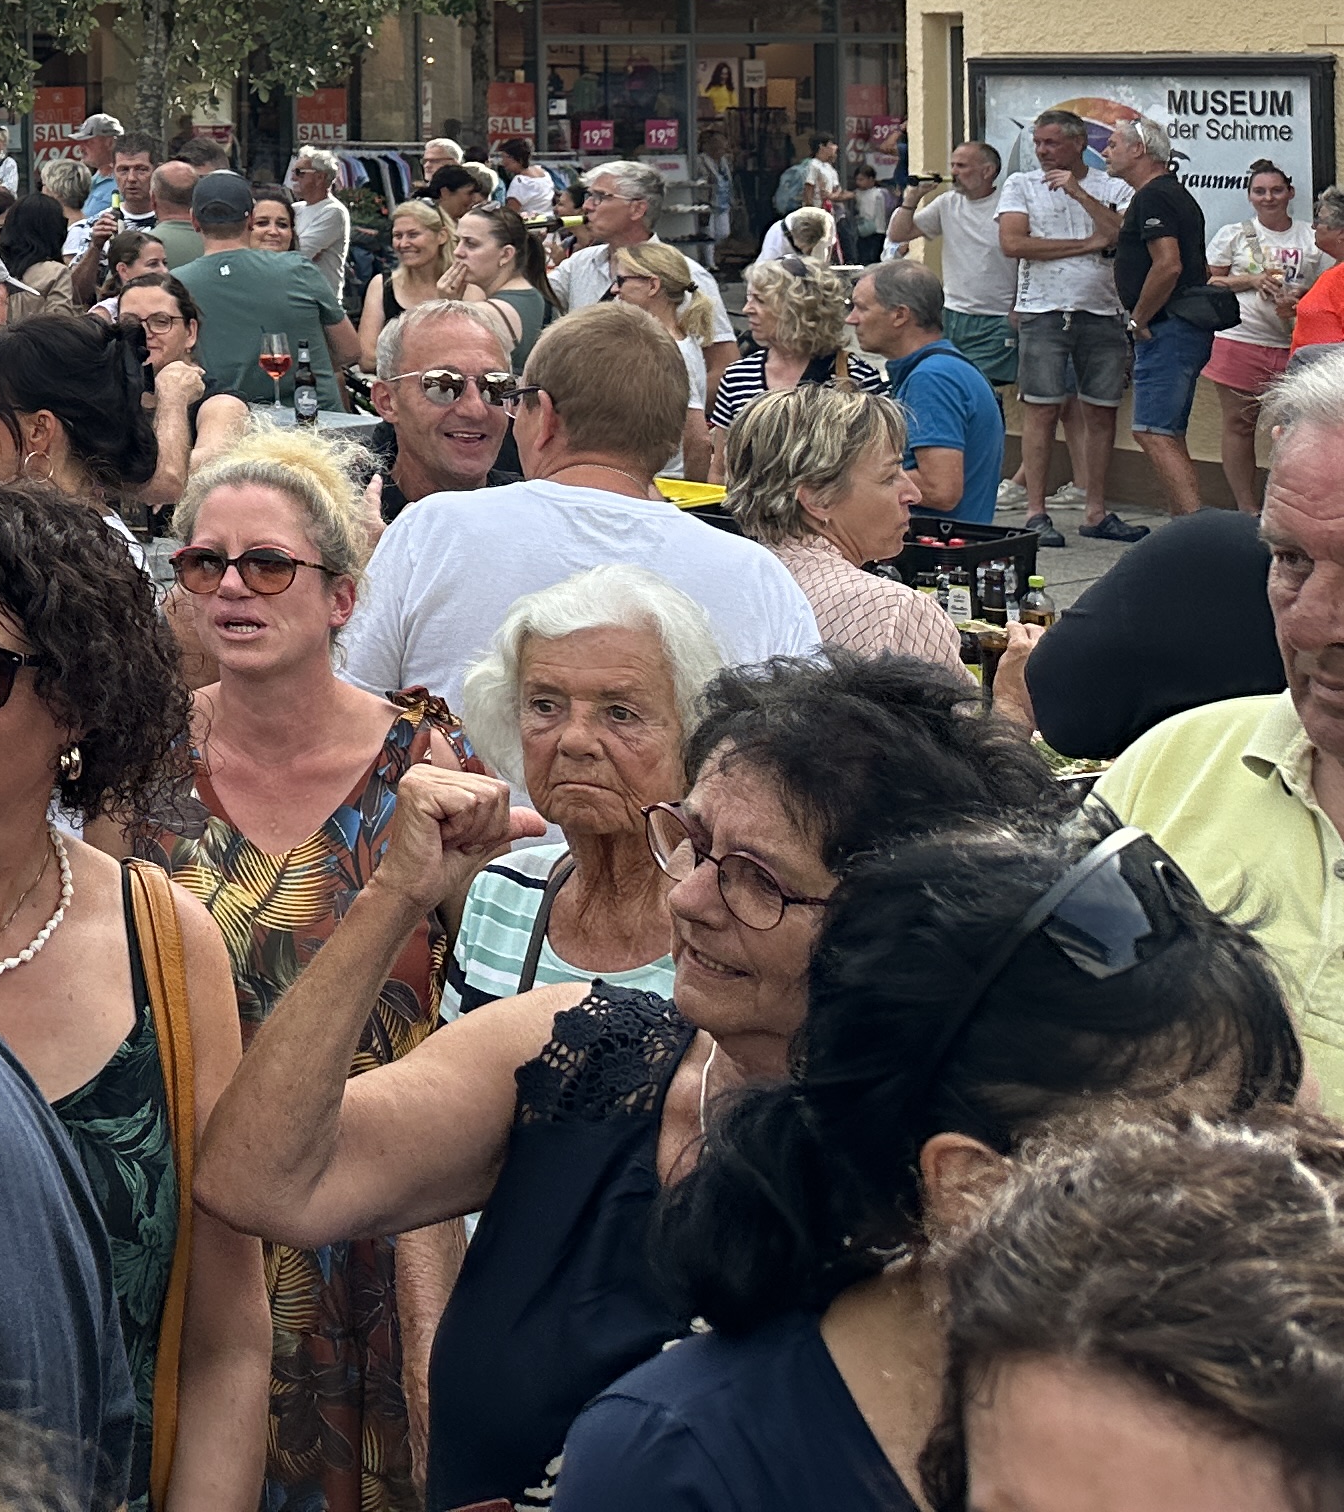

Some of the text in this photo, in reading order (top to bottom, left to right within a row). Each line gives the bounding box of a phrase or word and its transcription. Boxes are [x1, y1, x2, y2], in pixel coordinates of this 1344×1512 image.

[1167, 89, 1293, 117] MUSEUM
[300, 125, 343, 141] SALE
[490, 118, 529, 133] SALE
[1167, 119, 1293, 142] der Schirme
